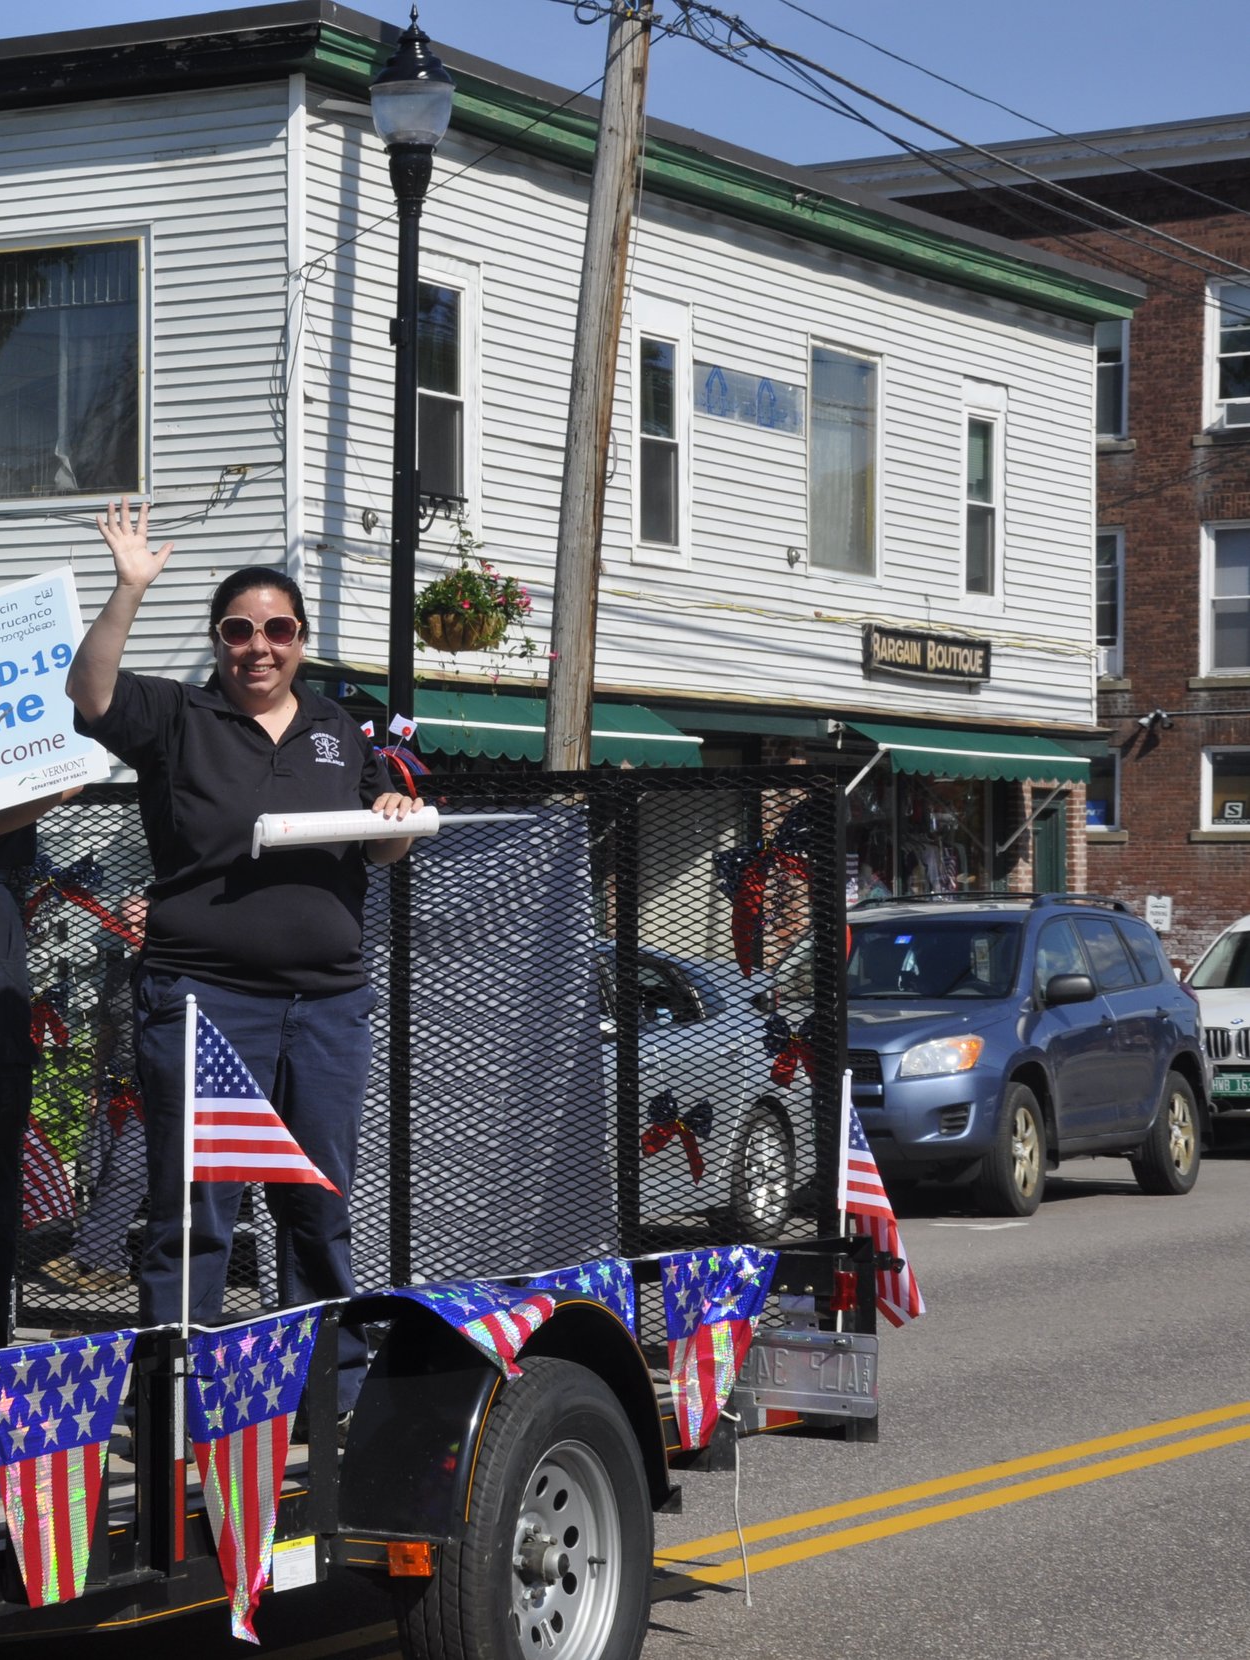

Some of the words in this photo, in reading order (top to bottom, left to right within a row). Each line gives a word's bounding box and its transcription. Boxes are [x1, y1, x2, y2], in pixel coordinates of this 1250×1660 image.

[42, 757, 85, 778] VERMONT
[31, 778, 62, 791] DEPARTMENT
[70, 770, 88, 780] HEALTH
